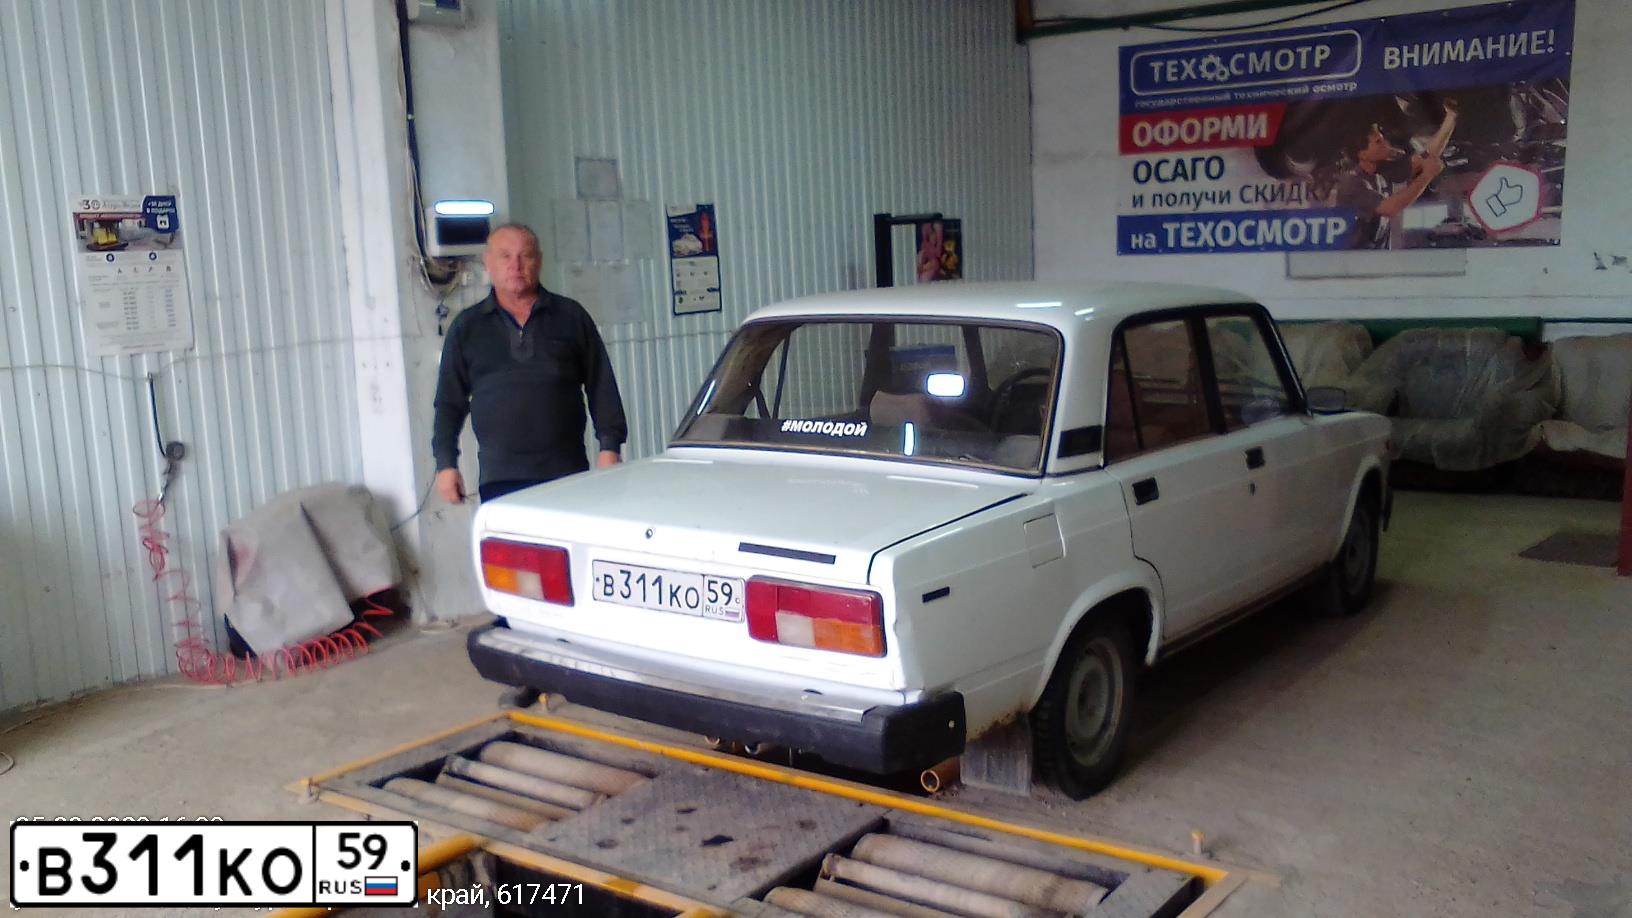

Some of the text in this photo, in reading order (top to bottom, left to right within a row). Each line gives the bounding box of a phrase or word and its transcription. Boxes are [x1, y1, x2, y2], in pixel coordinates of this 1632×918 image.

[1383, 29, 1555, 70] ВНИМАНИЕ!
[1312, 82, 1358, 95] осмотр
[1132, 113, 1268, 147] ОФОРМИ
[1133, 155, 1225, 184] ОСАГО
[1132, 193, 1143, 208] и
[1152, 189, 1231, 211] получи
[1131, 217, 1347, 249] на ТЕХОСМОТР
[781, 420, 868, 437] #МОЛОДОЙ
[603, 569, 733, 609] В311КО 59
[705, 605, 724, 616] RUS
